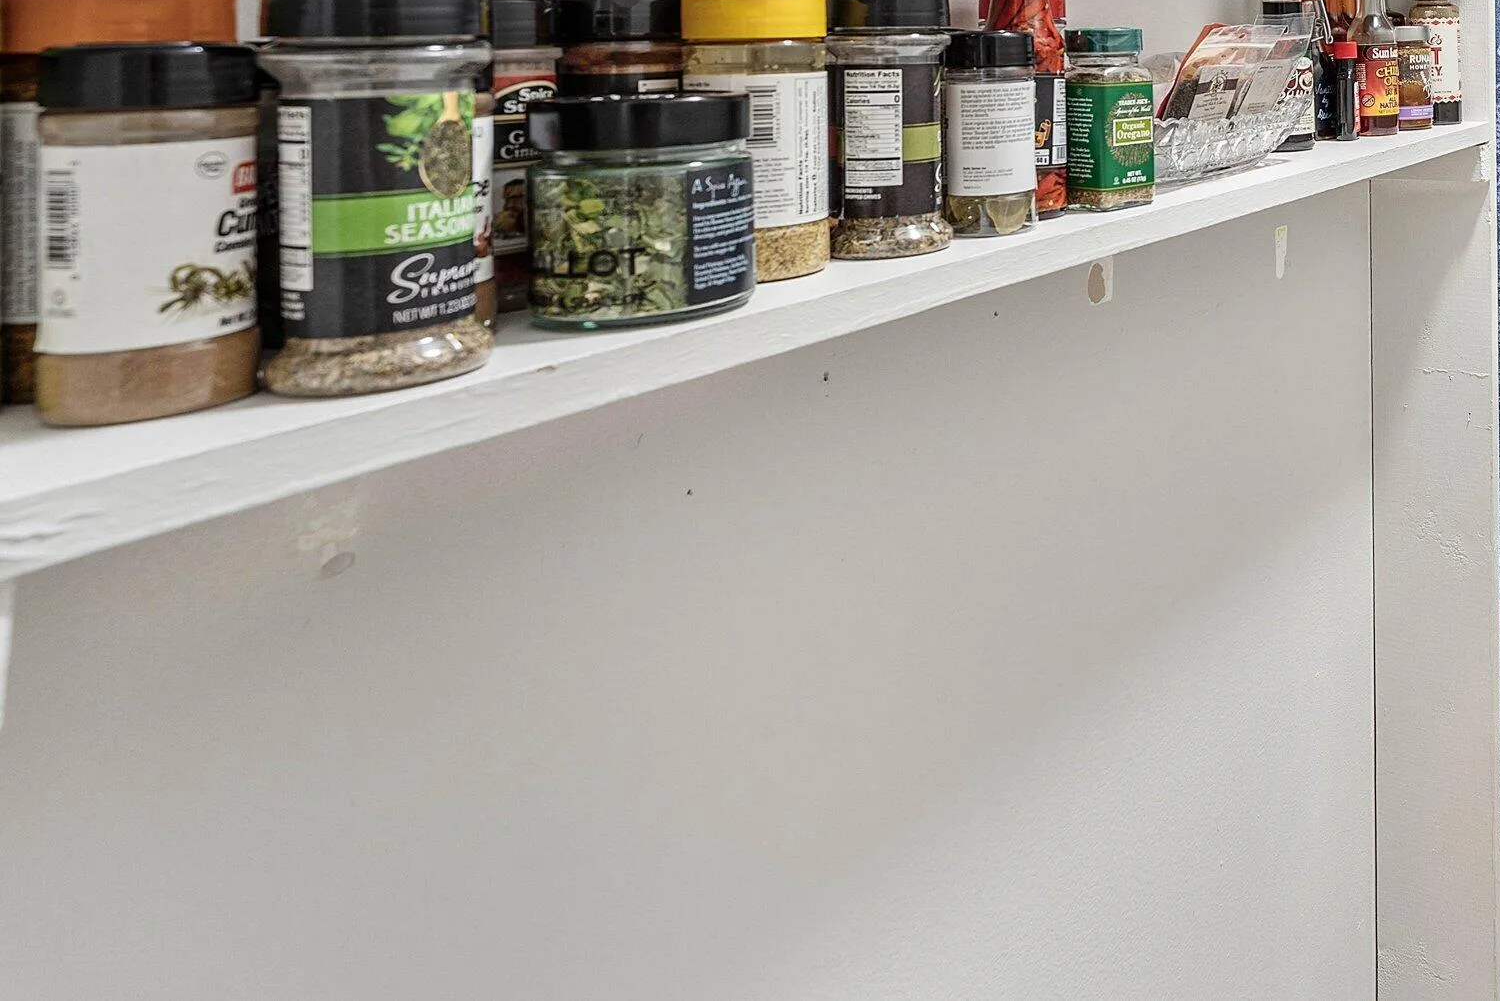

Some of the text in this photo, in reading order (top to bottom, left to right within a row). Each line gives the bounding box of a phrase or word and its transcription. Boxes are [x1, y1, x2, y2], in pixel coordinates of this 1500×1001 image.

[1372, 47, 1389, 58] Sun
[893, 95, 900, 103] 0
[1121, 121, 1146, 132] Organic
[1116, 129, 1151, 140] Oregano
